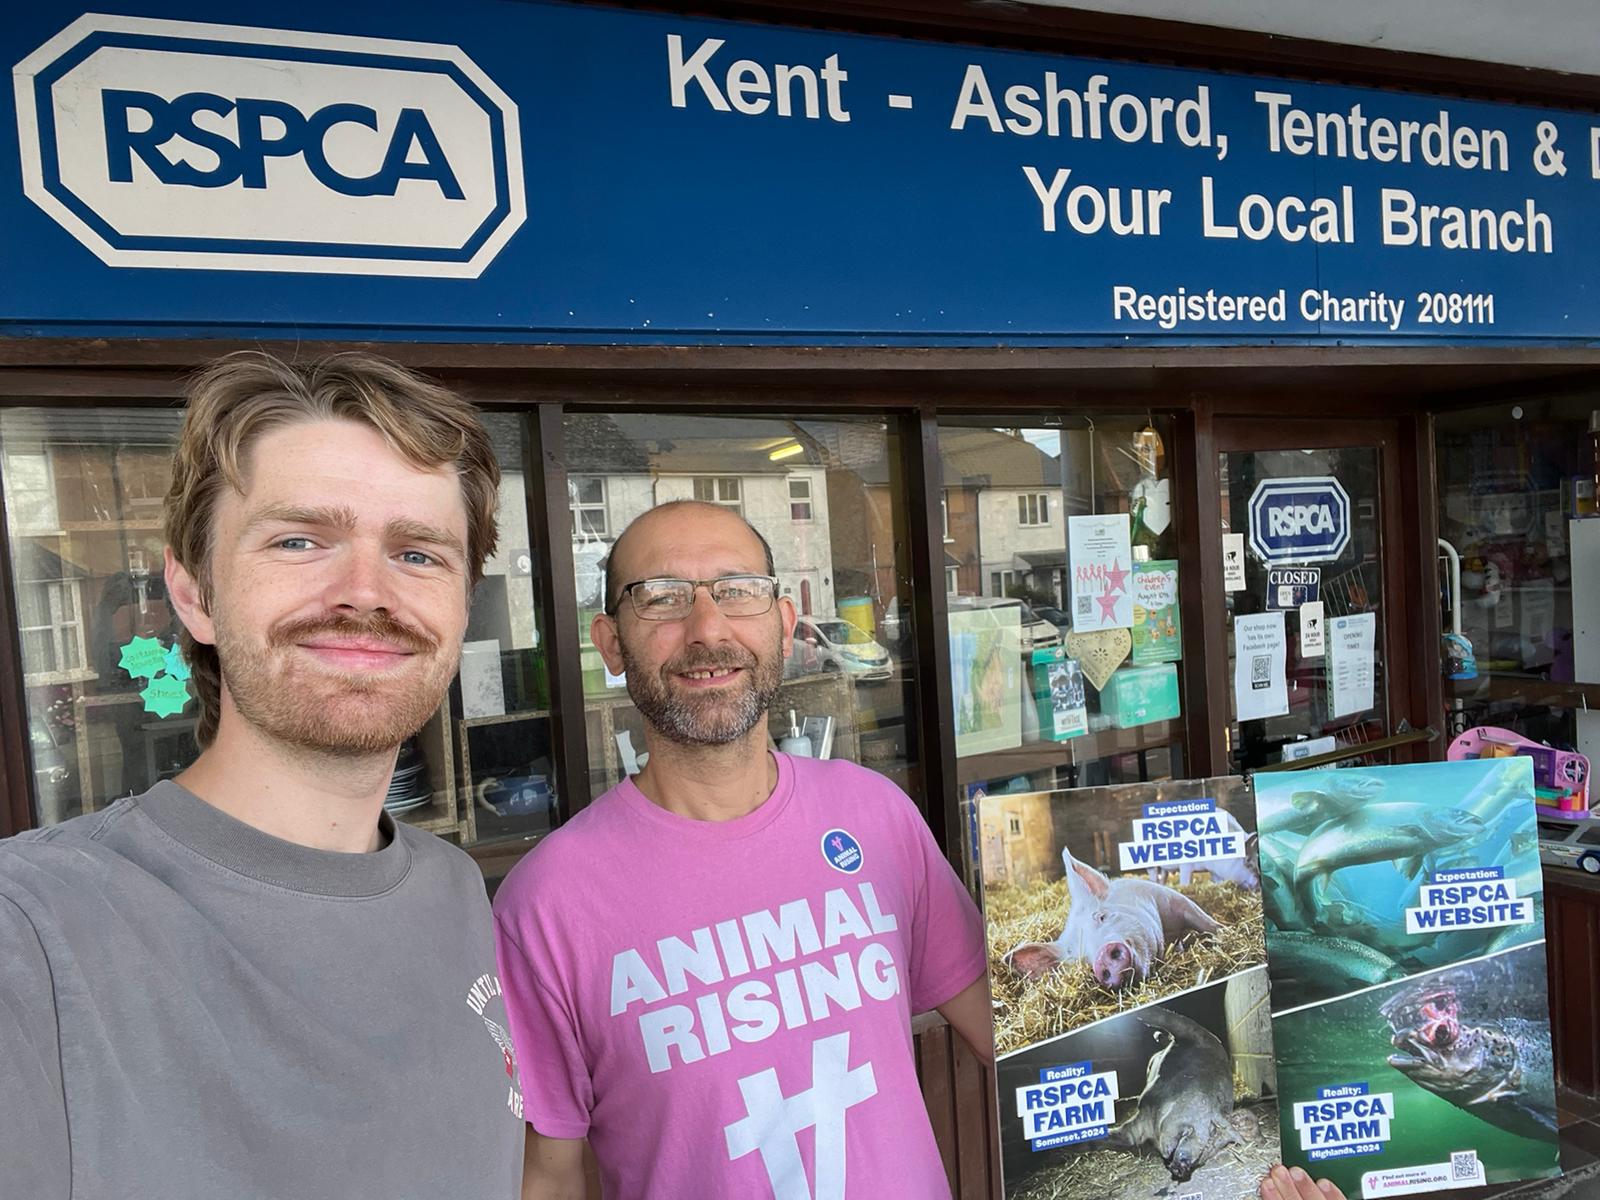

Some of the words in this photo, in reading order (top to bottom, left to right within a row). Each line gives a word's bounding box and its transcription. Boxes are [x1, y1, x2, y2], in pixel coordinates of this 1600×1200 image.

[666, 34, 851, 122] Kent
[888, 94, 913, 109] -
[951, 64, 1229, 161] Ashford,
[1255, 91, 1509, 172] Tenterden
[1533, 120, 1568, 177] &
[100, 88, 467, 201] RSPCA
[1022, 166, 1172, 236] Your
[1202, 176, 1355, 243] Local
[1380, 187, 1554, 254] Branch
[1112, 285, 1287, 329] Registered
[1300, 290, 1405, 331] Charity
[1417, 292, 1495, 324] 208111
[1268, 504, 1336, 537] RSPCA
[1269, 570, 1318, 585] CLOSED
[1148, 803, 1210, 816] Expectation:
[1142, 816, 1221, 841] RSPCA
[833, 846, 858, 864] ANIMAL
[839, 853, 860, 868] RISING
[1128, 836, 1237, 865] WEBSITE
[1435, 870, 1498, 882] Expectation:
[1428, 883, 1510, 906] RSPCA
[1414, 902, 1525, 928] WEBSITE
[610, 882, 898, 1017] ANIMAL
[466, 973, 496, 1016] UNTIL
[639, 943, 900, 1074] RISING
[1046, 1066, 1085, 1080] Reality:
[1025, 1077, 1111, 1110] RSPCA
[1323, 1087, 1362, 1098] Reality:
[1033, 1100, 1105, 1133] FARM
[1303, 1097, 1387, 1124] RSPCA
[1035, 1134, 1080, 1148] Somerset,
[1081, 1127, 1105, 1139] 2024
[1309, 1119, 1380, 1144] FARM
[1311, 1147, 1356, 1159] Highlands,
[1356, 1143, 1380, 1153] 2024
